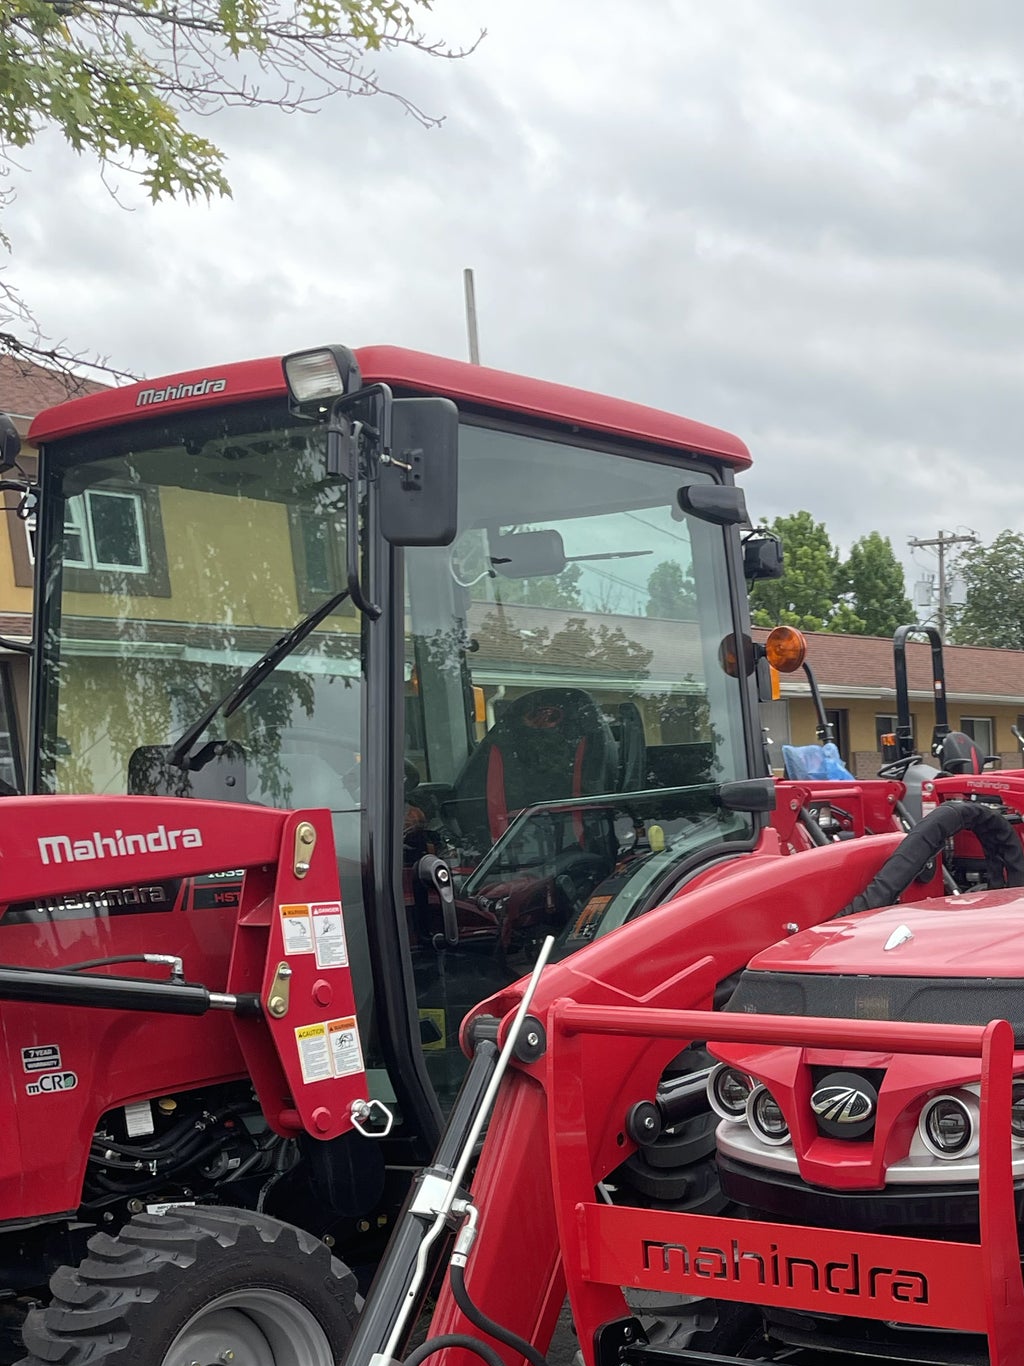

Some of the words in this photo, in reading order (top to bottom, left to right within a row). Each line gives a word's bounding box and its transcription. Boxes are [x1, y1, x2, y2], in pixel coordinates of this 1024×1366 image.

[136, 379, 226, 406] Mahindra
[37, 825, 203, 865] Mahindra
[302, 1028, 324, 1038] CAUTION
[641, 1239, 929, 1305] mahindra
